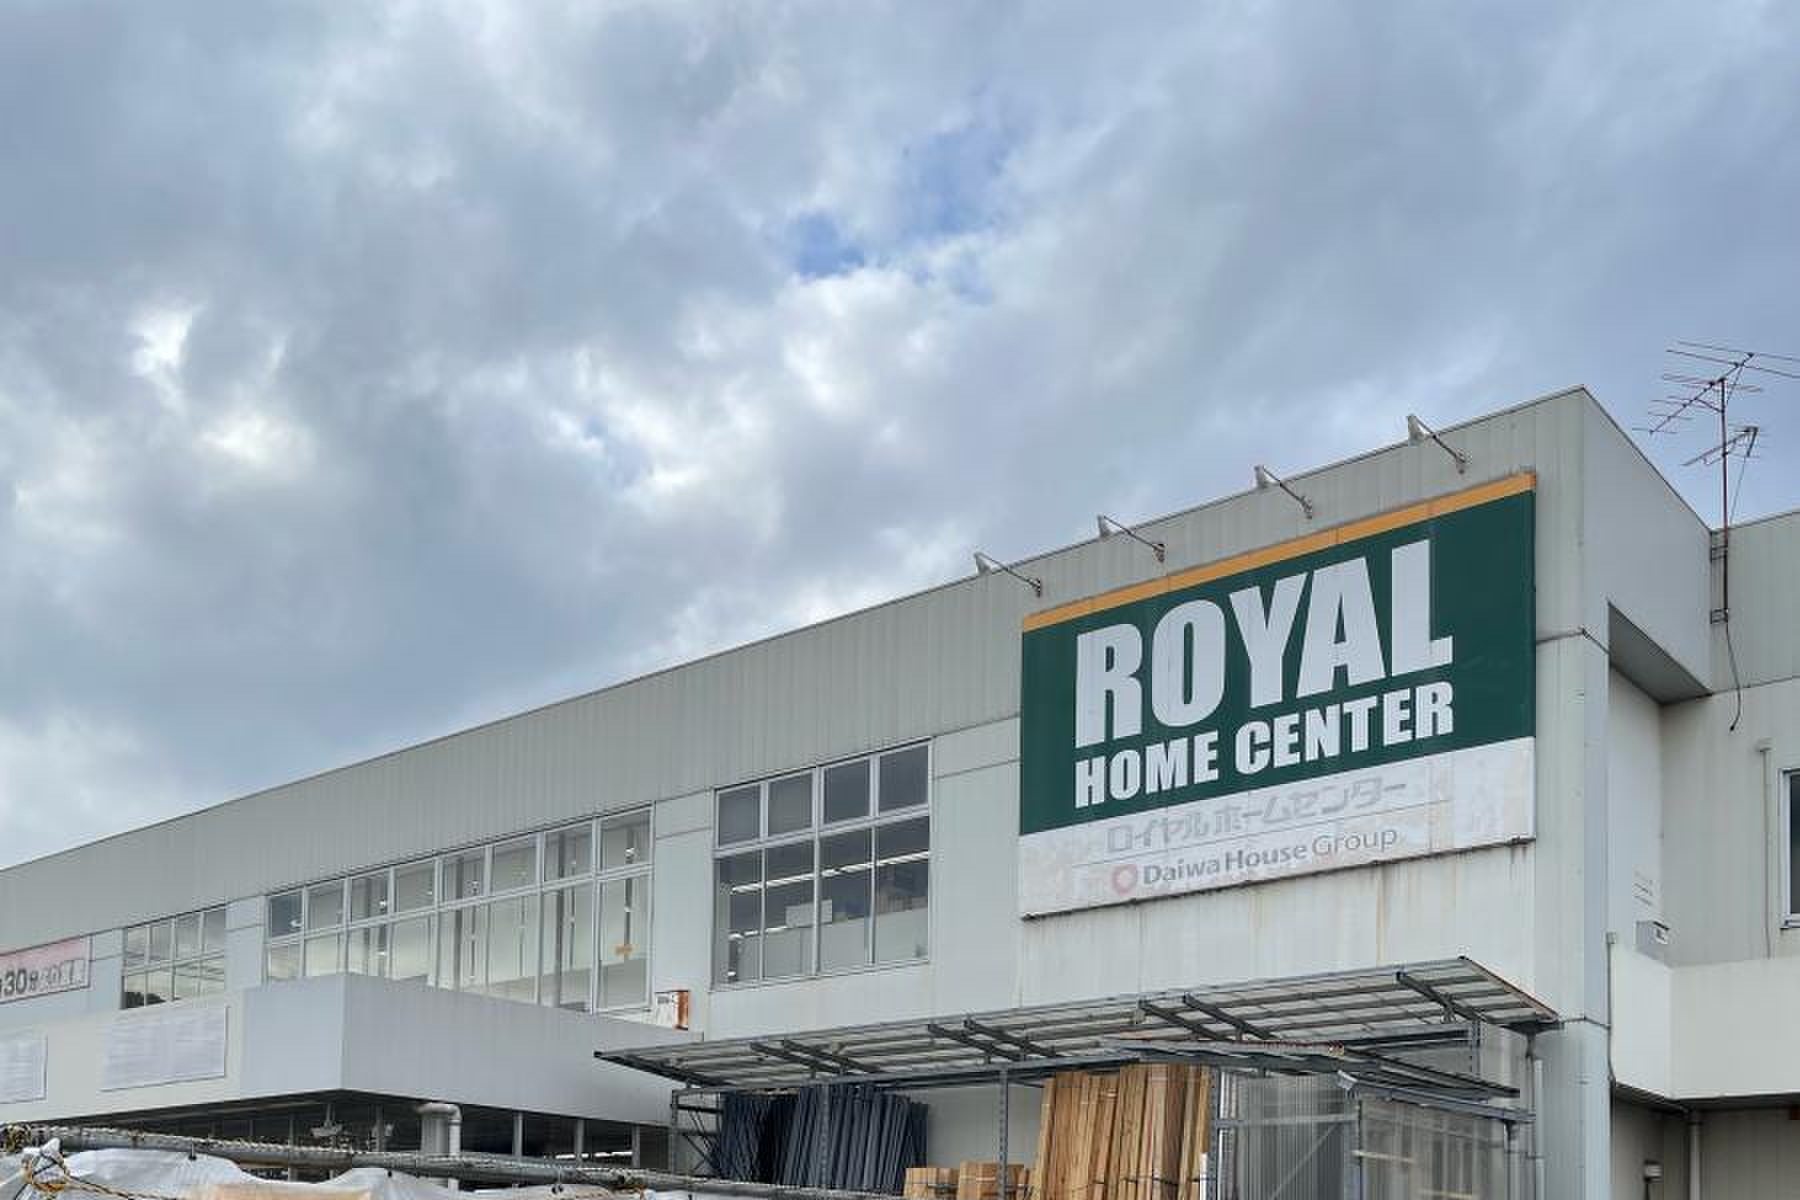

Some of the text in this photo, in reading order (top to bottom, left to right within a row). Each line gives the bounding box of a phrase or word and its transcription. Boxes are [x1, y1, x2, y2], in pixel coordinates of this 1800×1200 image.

[1075, 539, 1453, 748] ROYAL
[1075, 681, 1453, 809] HOME CENTER
[1106, 776, 1407, 851] ロイヤルホームセンター
[1142, 827, 1399, 885] Daiwa House Group
